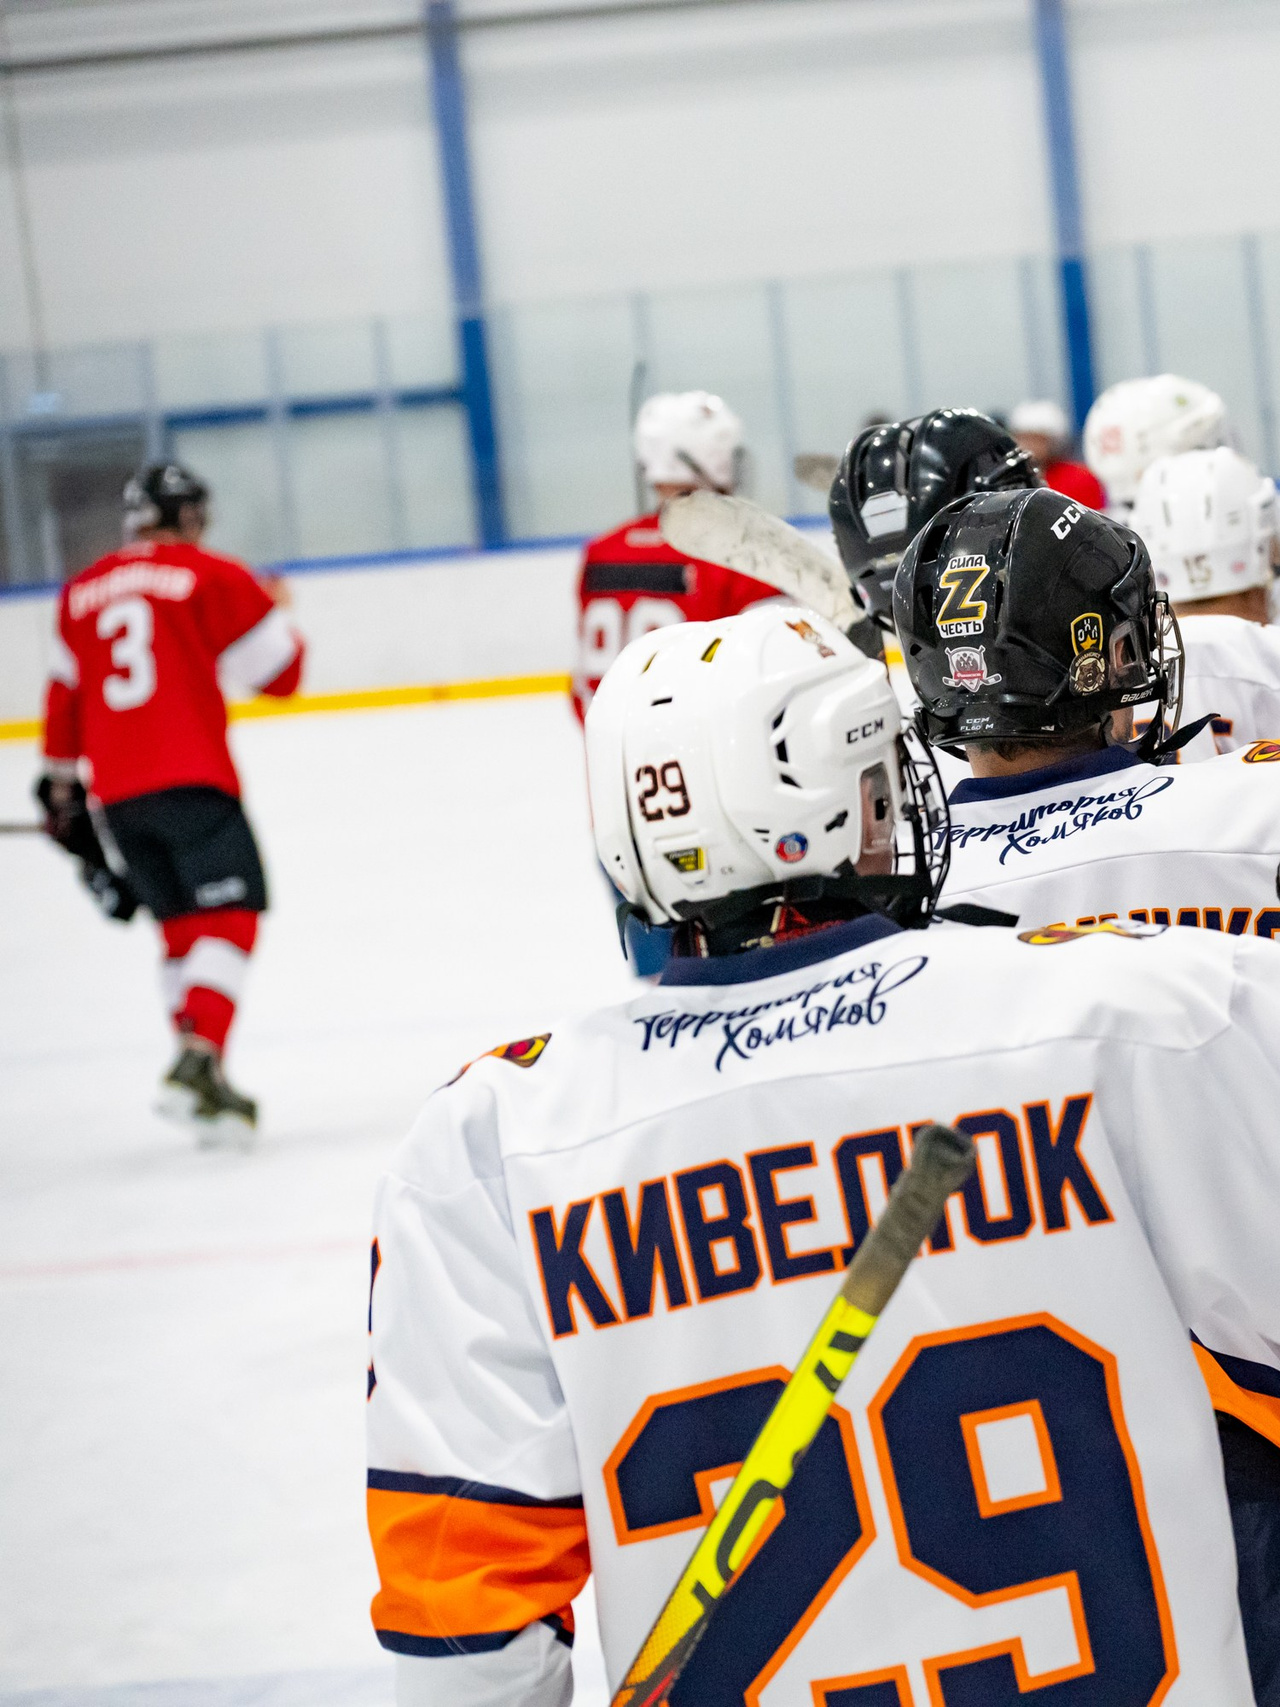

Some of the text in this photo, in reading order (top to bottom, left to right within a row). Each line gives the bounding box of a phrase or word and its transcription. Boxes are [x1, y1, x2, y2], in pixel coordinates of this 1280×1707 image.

[949, 556, 983, 570] СИЛА
[938, 567, 989, 625] Z
[98, 598, 156, 712] 3
[941, 621, 983, 636] ЧЕСТЬ
[846, 717, 885, 744] CCM
[635, 760, 692, 823] 29
[601, 1312, 1181, 1707] 29
